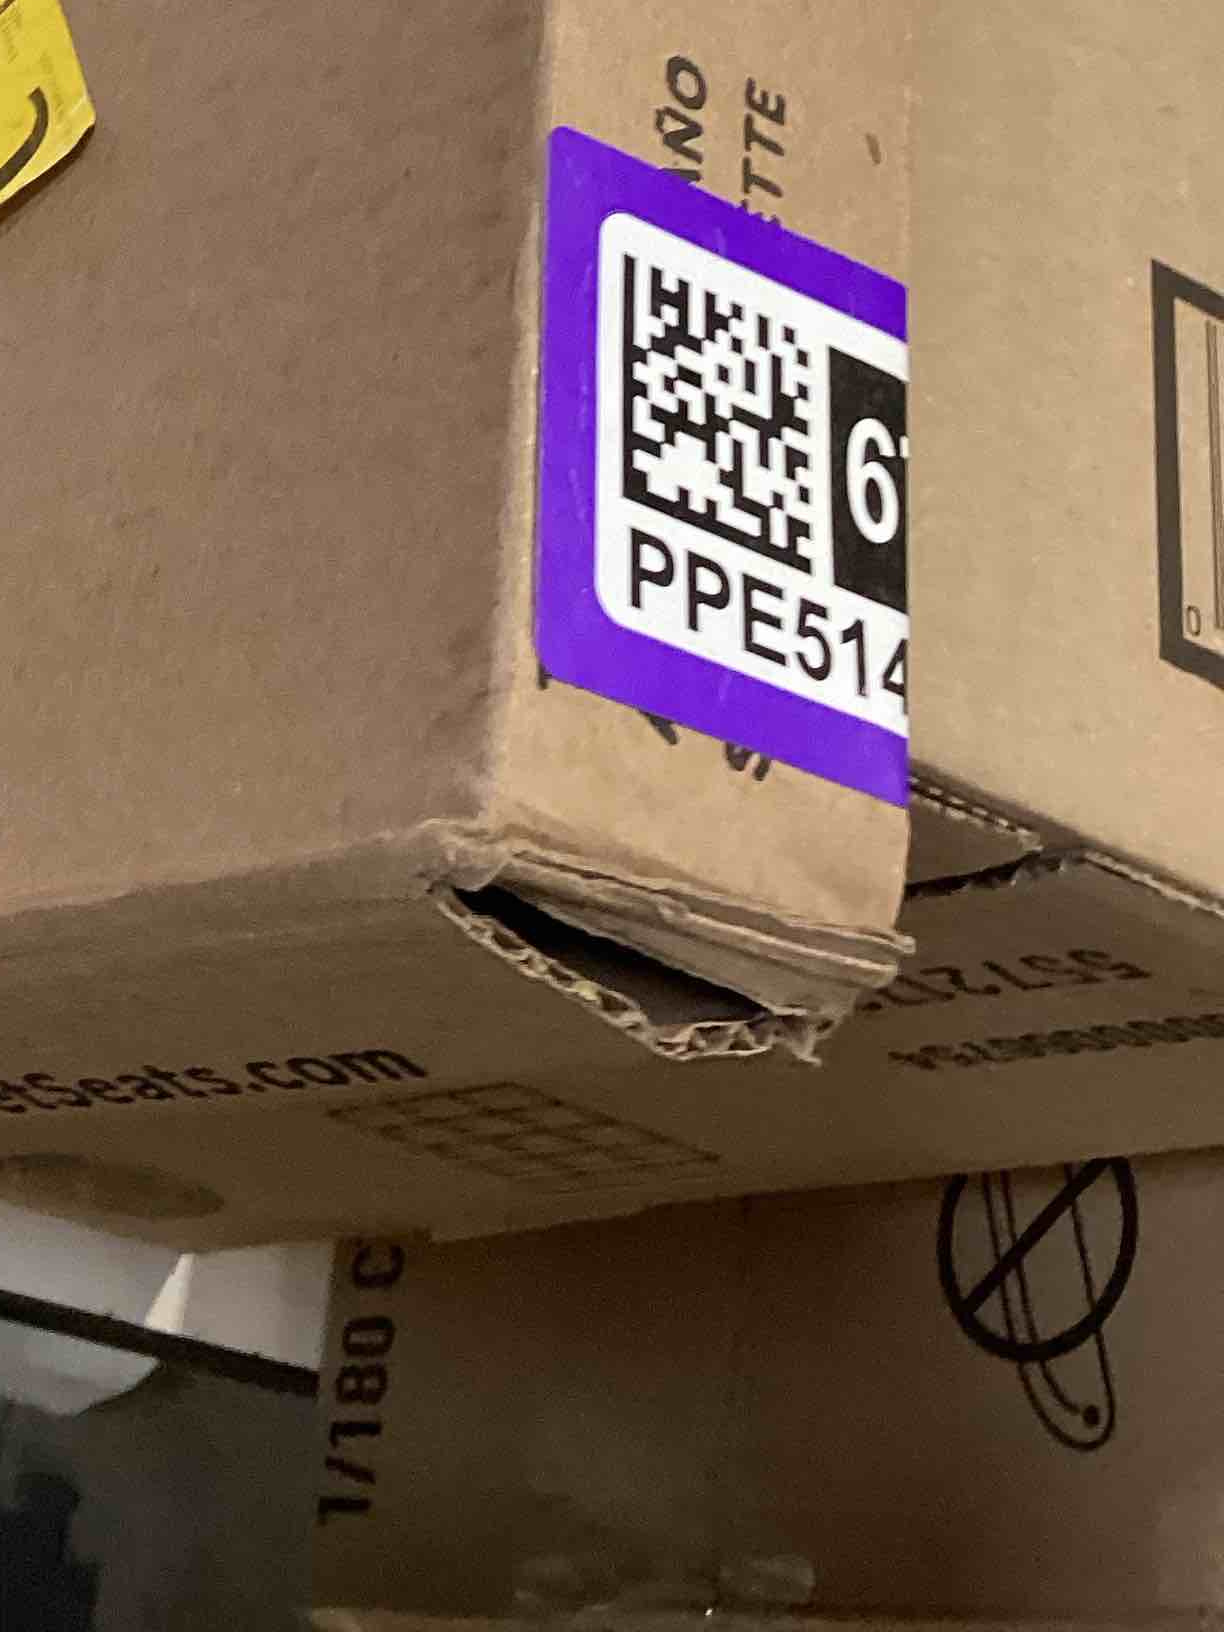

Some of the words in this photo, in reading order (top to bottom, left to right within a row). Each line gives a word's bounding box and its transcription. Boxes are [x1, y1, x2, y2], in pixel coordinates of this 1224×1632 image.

[655, 55, 708, 182] ÑO
[741, 76, 787, 225] TTE
[317, 1315, 397, 1526] 1/180
